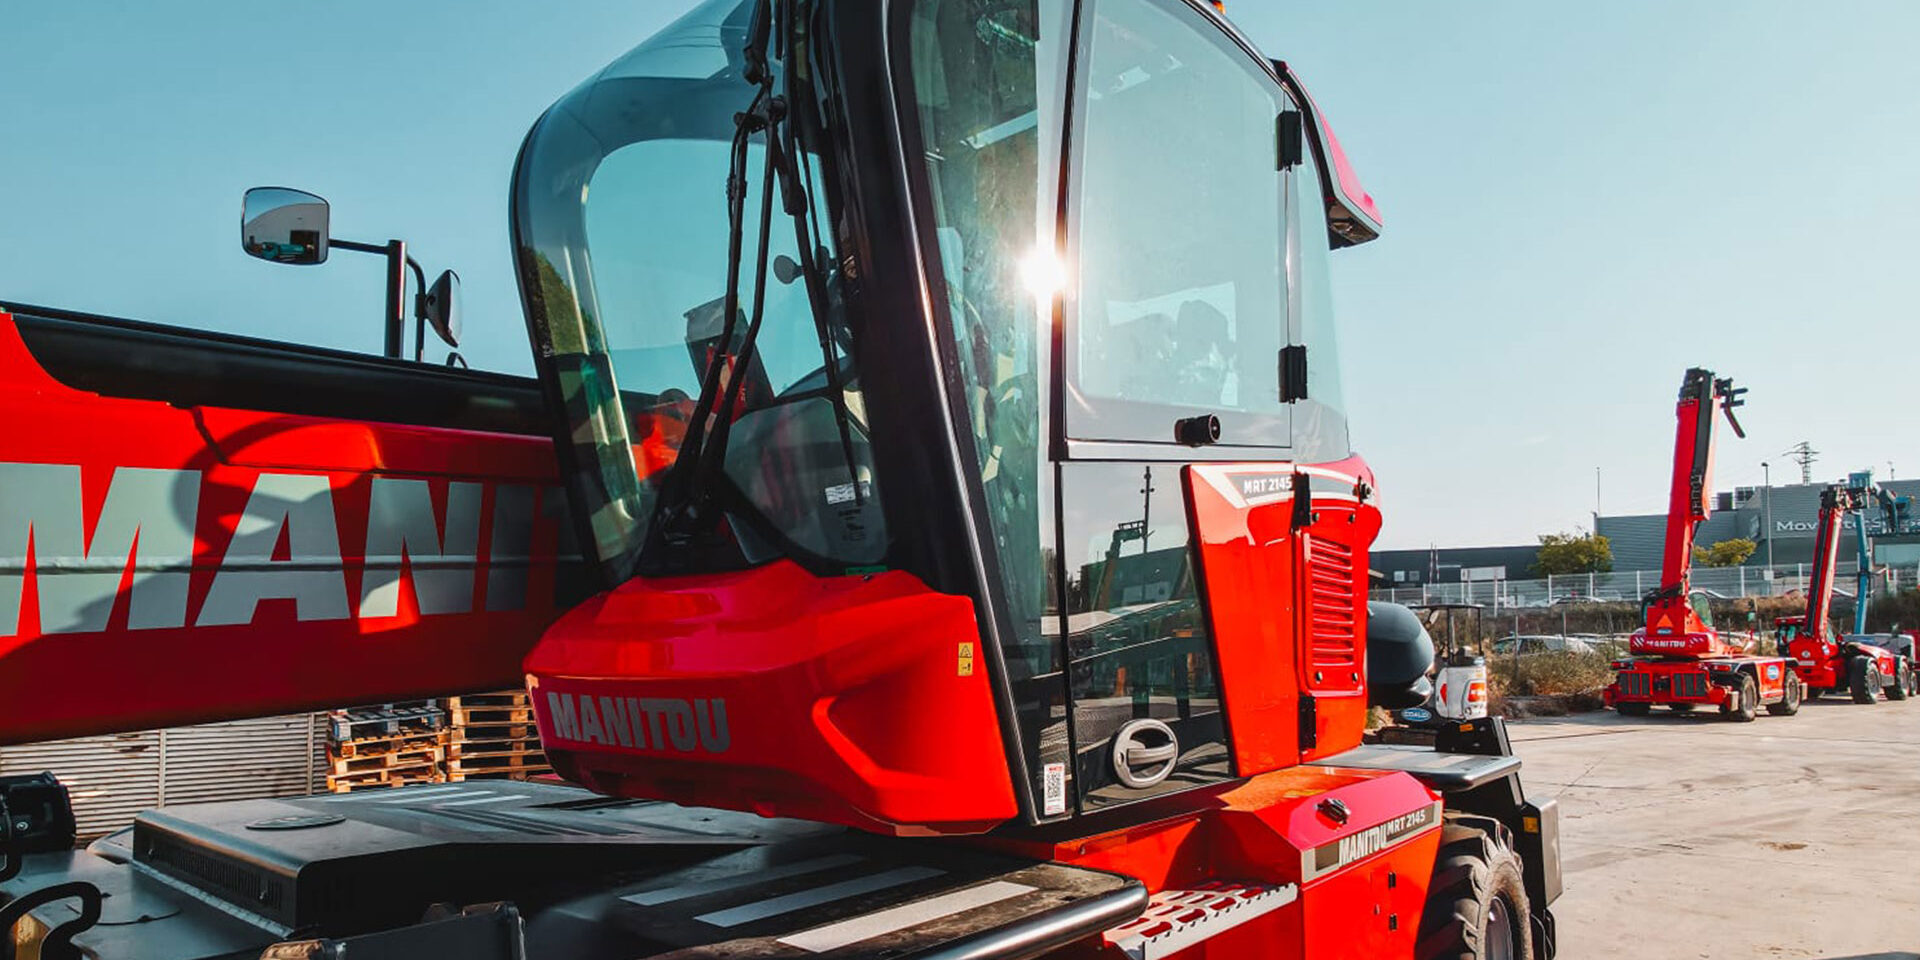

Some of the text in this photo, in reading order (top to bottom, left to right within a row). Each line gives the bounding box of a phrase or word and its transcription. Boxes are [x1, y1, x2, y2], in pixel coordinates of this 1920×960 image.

[1243, 476, 1293, 494] MRT 2145
[547, 691, 731, 754] MANITOU
[1339, 809, 1426, 867] MANITOU MRT 2145
